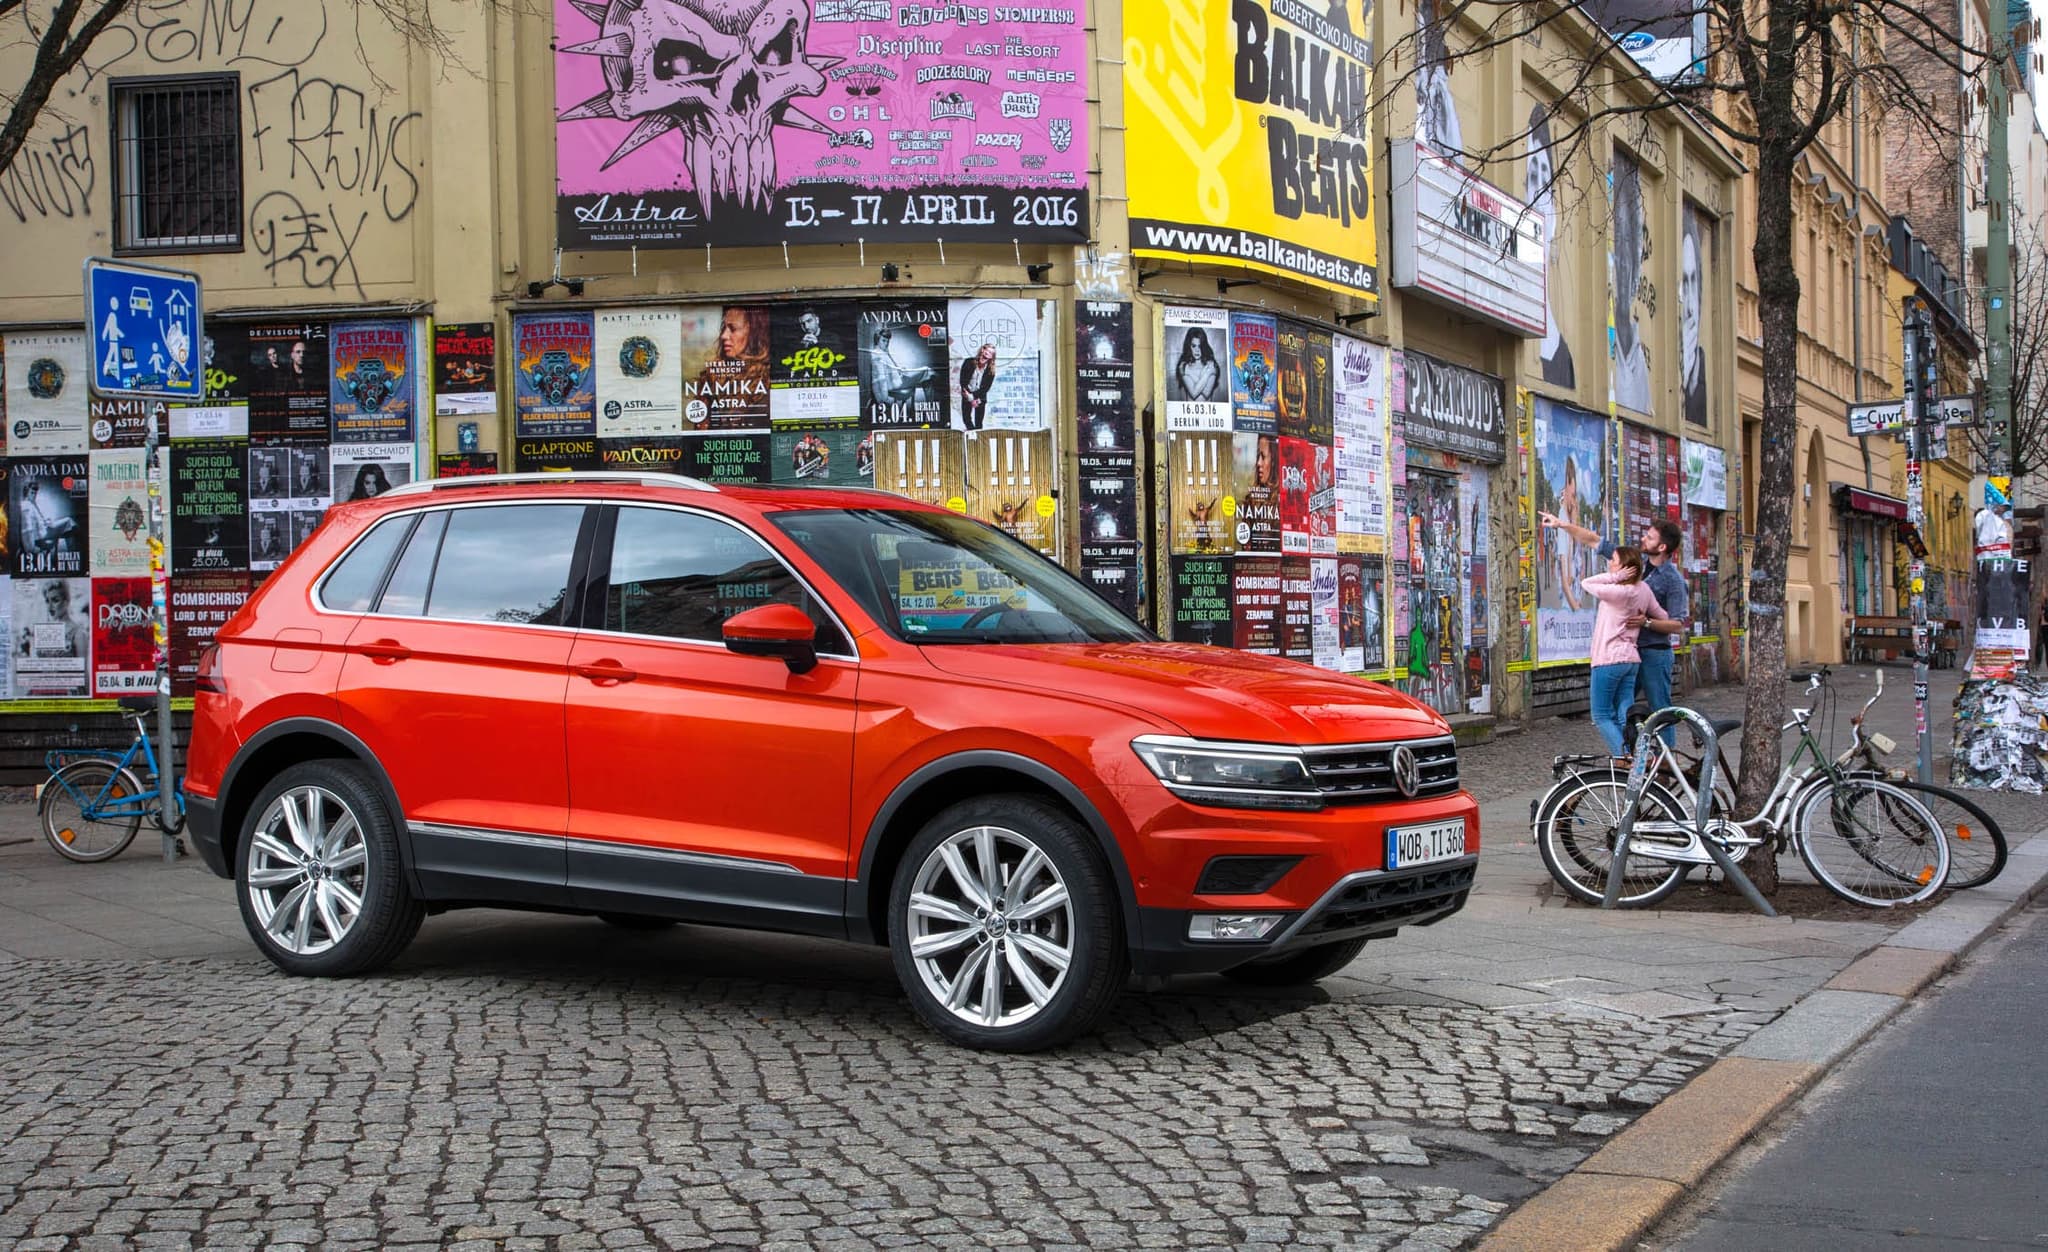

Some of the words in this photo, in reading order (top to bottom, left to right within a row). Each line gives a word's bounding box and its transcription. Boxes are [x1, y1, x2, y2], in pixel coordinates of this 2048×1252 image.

[1272, 0, 1314, 29] ROBERT
[1315, 16, 1341, 48] SOKO
[1343, 34, 1352, 54] DJ
[1353, 41, 1368, 61] SET
[1005, 36, 1021, 45] THE
[857, 35, 944, 60] Discipline
[966, 44, 1000, 56] LAST
[1005, 46, 1060, 57] RESORT
[1232, 0, 1367, 140] BALKAN
[1004, 102, 1036, 114] pasti
[1267, 116, 1369, 228] BEATS
[574, 194, 698, 222] Astra
[851, 196, 888, 225] 17.
[900, 195, 995, 225] APRIL
[1013, 196, 1078, 226] 2016
[1146, 226, 1372, 289] www.balkanbeats.de
[860, 311, 912, 324] ANDRA
[917, 310, 946, 323] DAY
[1165, 310, 1191, 318] FEMME
[1193, 312, 1226, 321] SCHMIDT
[969, 318, 1016, 333] ALLEN
[968, 333, 1016, 349] STONE
[685, 380, 767, 397] NAMIKA
[624, 400, 653, 410] ASTRA
[711, 399, 746, 409] ASTRA
[1182, 404, 1217, 415] 16.03.16
[871, 402, 912, 424] 13.04.
[32, 420, 61, 430] ASTRA
[1174, 417, 1200, 428] BERLIN
[1208, 418, 1224, 428] LIDO
[333, 447, 365, 457] FEMME
[367, 446, 410, 457] SCHMIDT
[522, 441, 595, 455] CLAPTONE
[704, 440, 727, 451] SUCH
[730, 440, 752, 451] GOLD
[187, 456, 208, 468] SUCH
[211, 456, 233, 468] GOLD
[696, 453, 711, 464] THE
[713, 452, 742, 463] STATIC
[744, 451, 761, 462] AGE
[13, 464, 58, 477] ANDRA
[61, 463, 88, 476] DAY
[179, 469, 195, 480] THE
[195, 468, 222, 480] STATIC
[727, 464, 743, 475] FUN
[183, 493, 197, 504] THE
[195, 504, 214, 516] TREE
[215, 504, 243, 516] CIRCLE
[1236, 504, 1280, 520] NAMIKA
[1251, 521, 1271, 531] ASTRA
[1185, 561, 1203, 573] SUCH
[1205, 561, 1222, 572] GOLD
[1178, 574, 1191, 585] THE
[1193, 574, 1215, 585] STATIC
[1216, 574, 1228, 584] AGE
[1235, 576, 1280, 589] COMBICHRIST
[1312, 567, 1336, 590] Indie
[1203, 586, 1216, 596] FUN
[173, 592, 249, 606] COMBICHRIST
[1182, 598, 1195, 609] THE
[1196, 598, 1226, 609] UPRISING
[175, 611, 196, 622] LORD
[197, 611, 209, 621] OF
[210, 611, 226, 621] THE
[1192, 610, 1208, 621] TREE
[1209, 610, 1231, 621] CIRCLE
[1399, 832, 1422, 862] WOB
[1431, 829, 1443, 858] TI
[1446, 826, 1463, 854] 368
